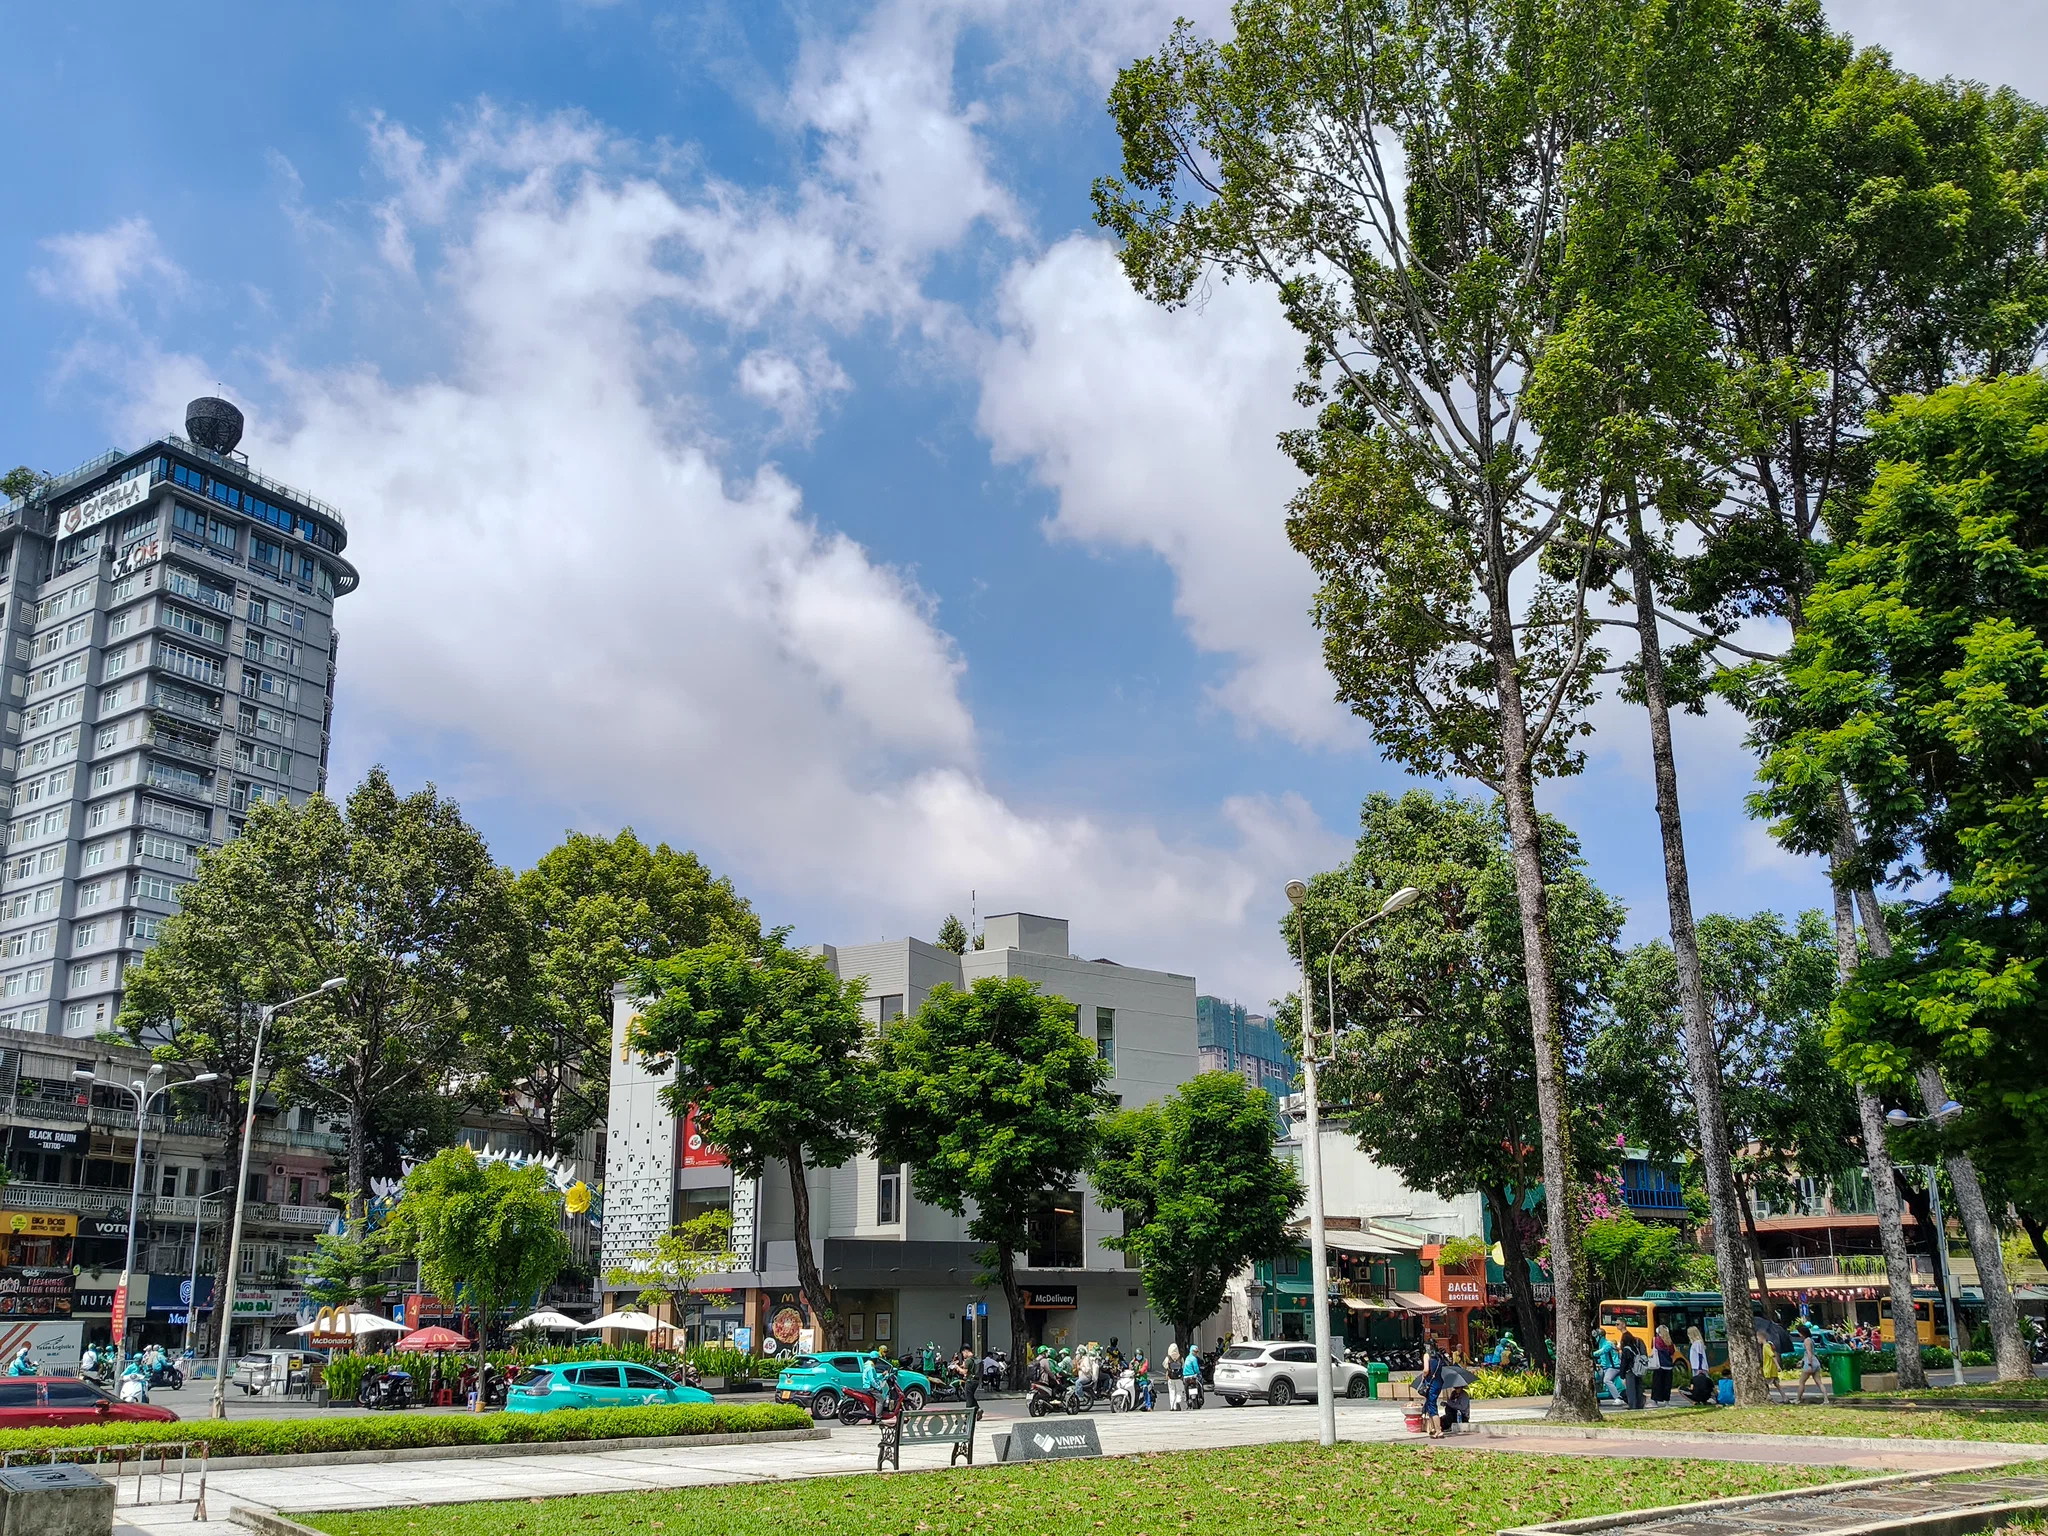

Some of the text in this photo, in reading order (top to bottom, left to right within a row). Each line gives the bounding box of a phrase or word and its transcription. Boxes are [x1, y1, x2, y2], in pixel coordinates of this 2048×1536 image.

[83, 481, 140, 517] CAPELLA
[82, 494, 140, 526] HOLDINGS
[132, 539, 160, 563] ONE
[28, 1129, 53, 1141] BLACK
[42, 1141, 61, 1150] TATTOO
[31, 1216, 45, 1225] BIG
[47, 1217, 66, 1226] BOSS
[1448, 1283, 1479, 1292] BAGEL
[1035, 1294, 1075, 1305] McDelivery
[311, 1336, 353, 1345] McDonald's
[1055, 1434, 1086, 1446] VNPAY
